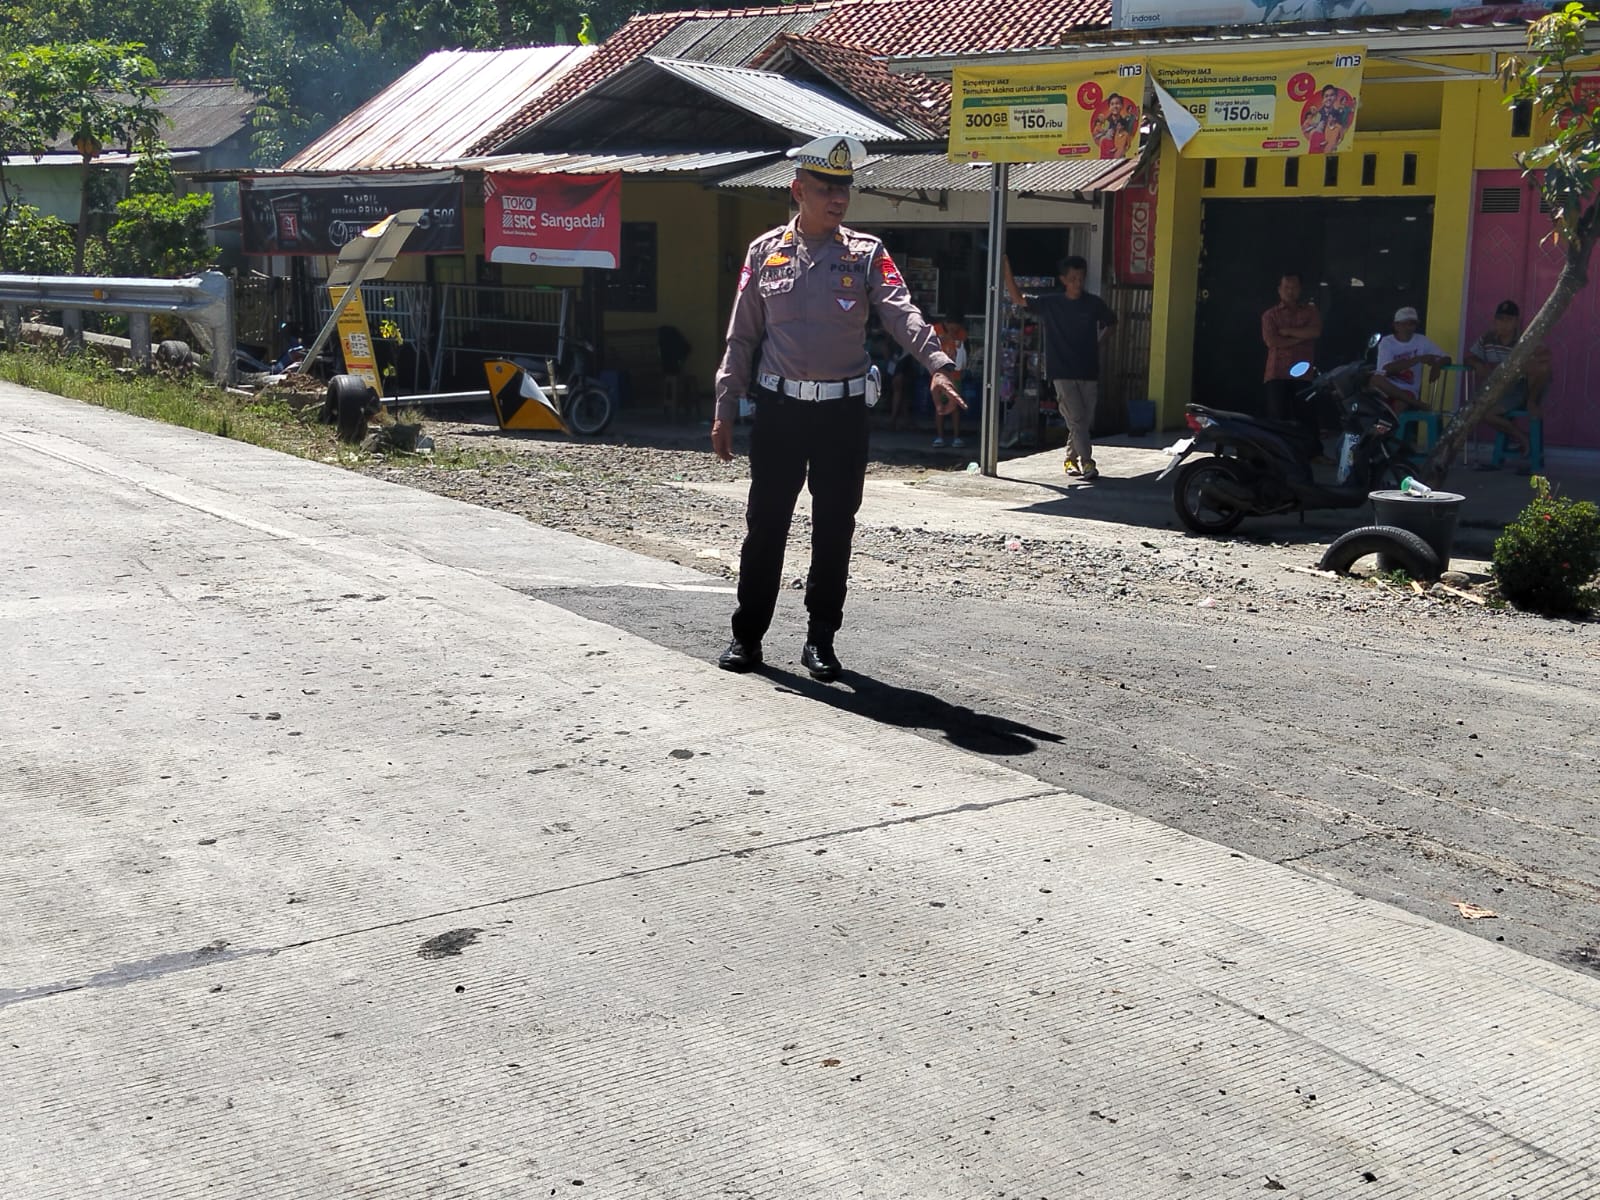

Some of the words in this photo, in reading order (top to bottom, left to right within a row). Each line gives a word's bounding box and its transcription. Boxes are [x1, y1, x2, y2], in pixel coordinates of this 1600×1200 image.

[965, 113, 992, 128] 300
[993, 112, 1008, 123] GB
[505, 197, 533, 210] TOKO
[514, 214, 537, 229] SRC
[540, 212, 605, 231] Sangadah
[1133, 208, 1147, 265] TOKO
[830, 263, 865, 273] POLRI
